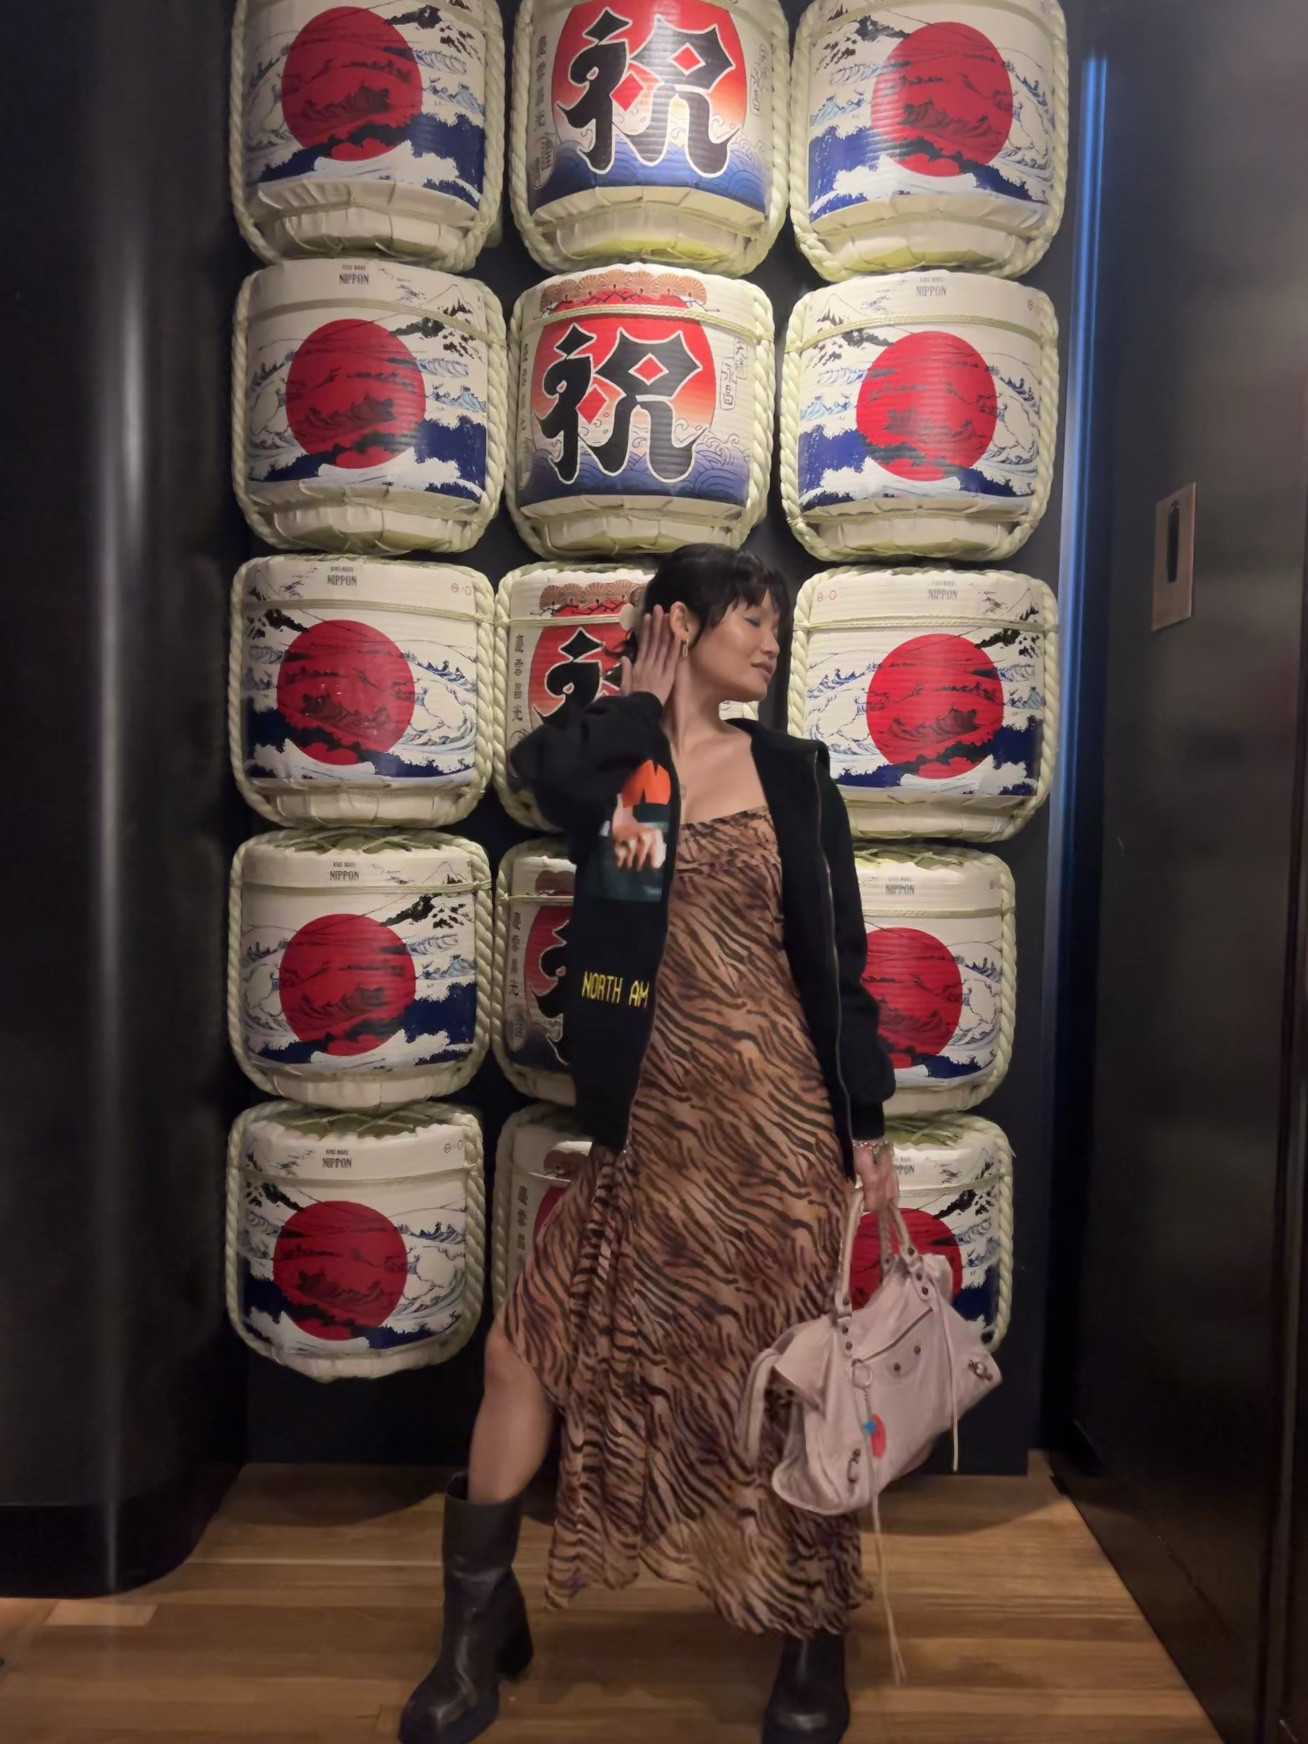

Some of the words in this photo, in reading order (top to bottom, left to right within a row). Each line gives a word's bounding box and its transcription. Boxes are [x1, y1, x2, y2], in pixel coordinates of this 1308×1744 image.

[339, 273, 369, 285] NIPPON
[916, 285, 946, 297] NIPPON
[327, 574, 357, 586] NIPPON
[928, 588, 958, 600] NIPPON
[329, 870, 359, 881] NIPPON
[885, 883, 915, 895] NIPPON
[581, 970, 623, 1004] NORTH
[322, 1157, 352, 1169] NIPPON
